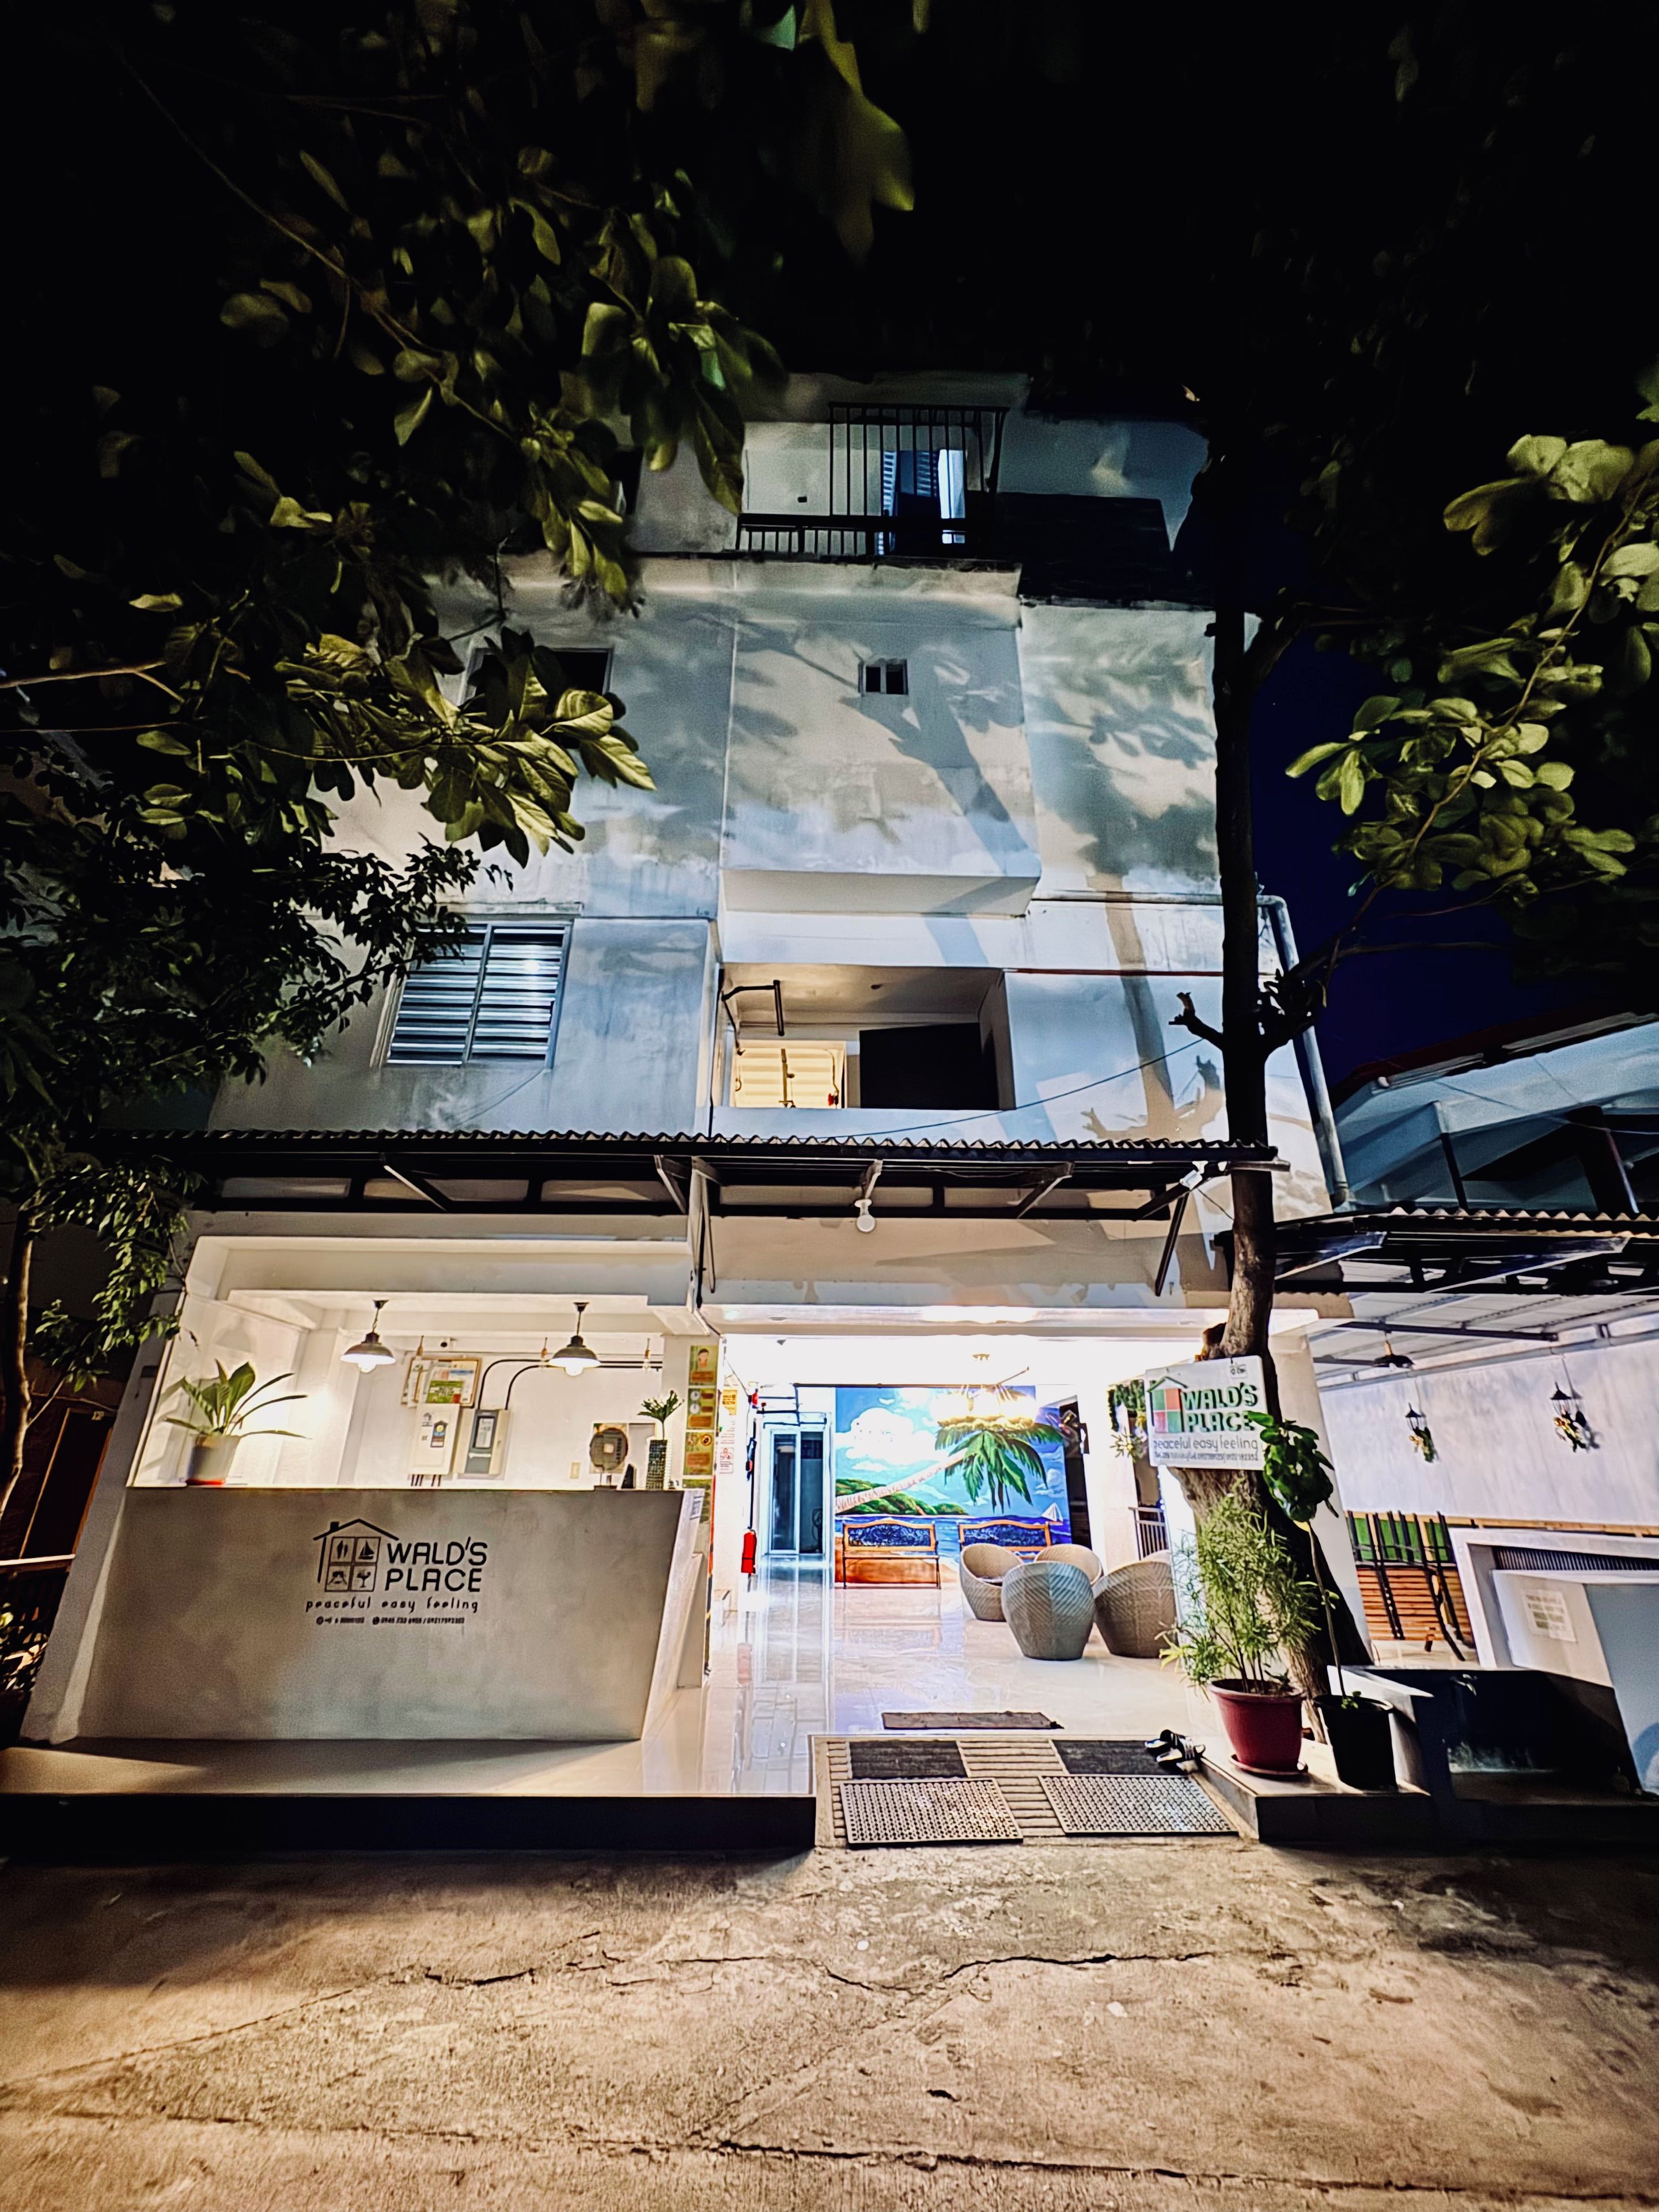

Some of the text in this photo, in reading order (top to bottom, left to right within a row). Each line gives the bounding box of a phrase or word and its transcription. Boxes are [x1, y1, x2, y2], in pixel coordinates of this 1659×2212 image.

[1180, 1382, 1258, 1410] WALD'S
[1187, 1411, 1256, 1433] PLACE
[1193, 1440, 1219, 1452] easy
[387, 1536, 488, 1566] WALD'S
[385, 1568, 483, 1592] PLACE
[305, 1596, 479, 1613] peaceful easy feeling
